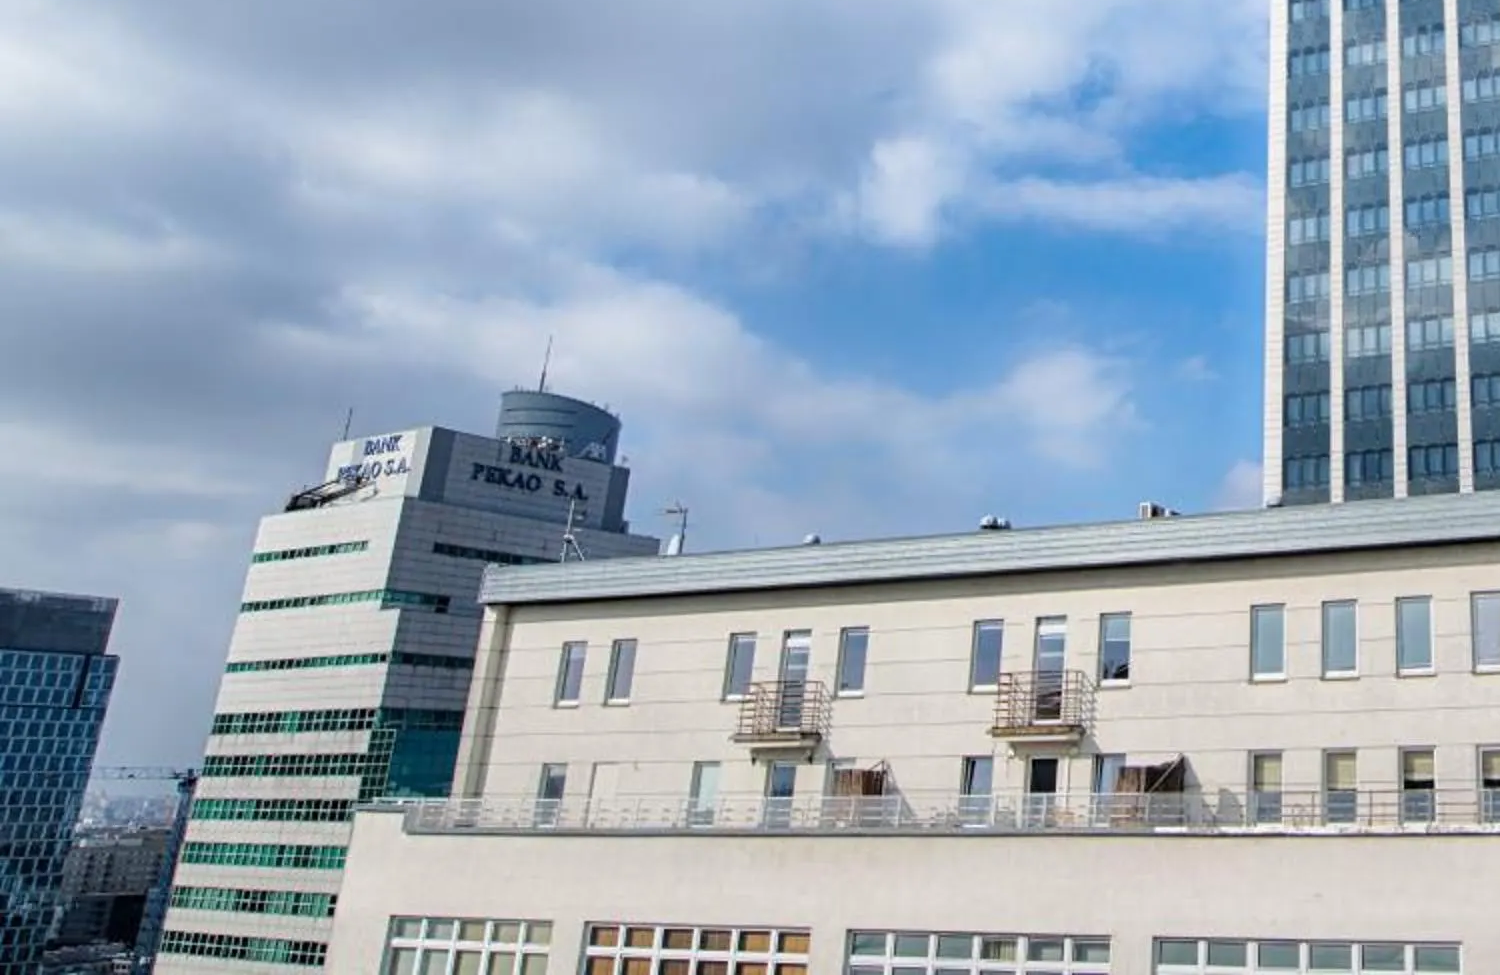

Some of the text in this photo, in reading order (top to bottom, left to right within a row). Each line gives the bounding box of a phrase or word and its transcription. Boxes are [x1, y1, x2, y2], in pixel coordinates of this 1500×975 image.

[364, 435, 402, 455] BANK
[510, 444, 563, 473] BANK
[471, 463, 541, 492] PEKAO
